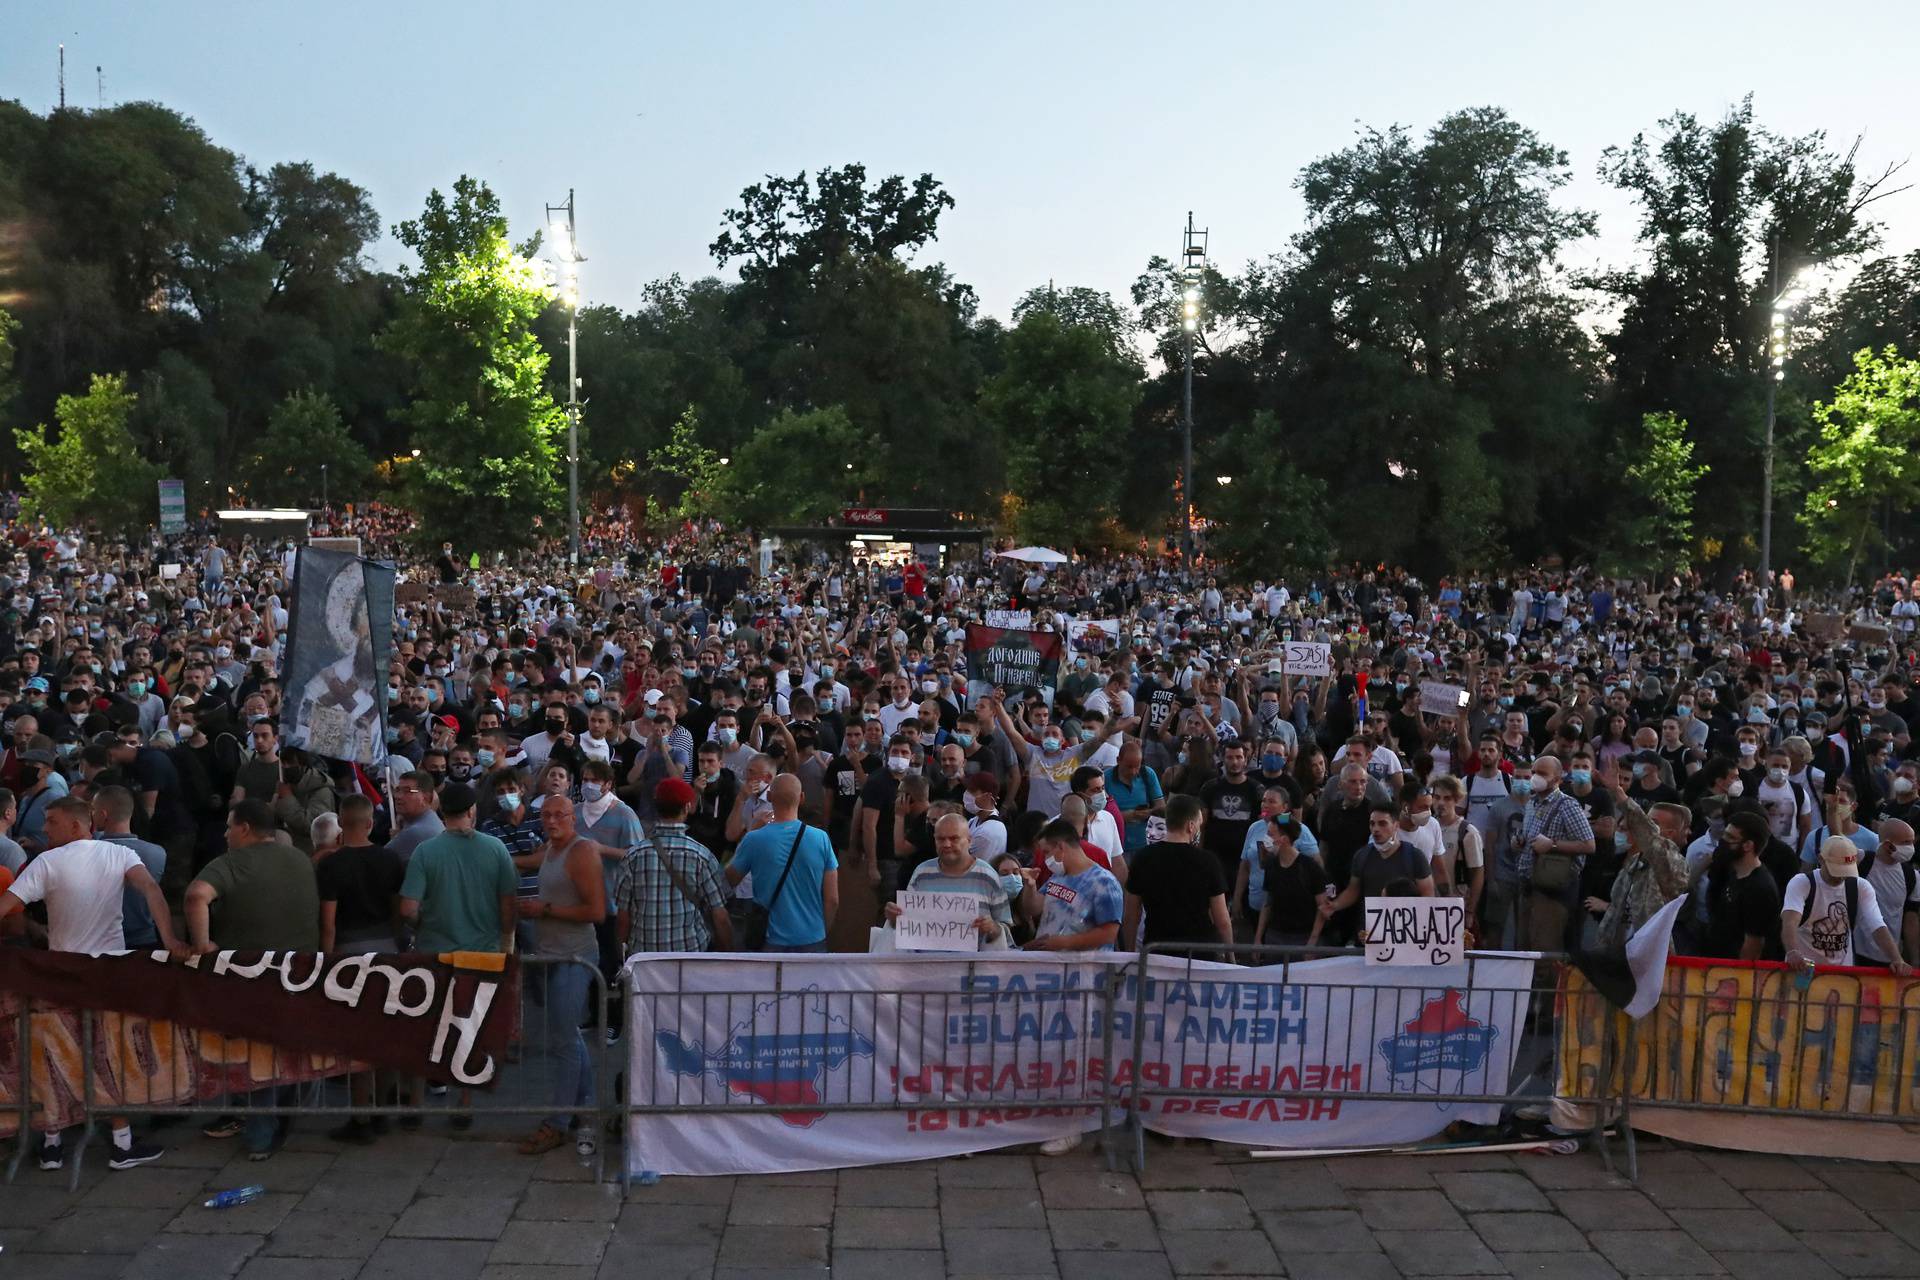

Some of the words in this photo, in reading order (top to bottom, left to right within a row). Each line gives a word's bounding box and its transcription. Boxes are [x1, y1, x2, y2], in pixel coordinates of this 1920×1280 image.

[1152, 690, 1174, 701] STATE
[1060, 888, 1075, 902] OVER
[904, 894, 926, 909] НИ
[932, 894, 977, 914] КУРТА
[899, 920, 922, 937] НИ
[926, 921, 977, 940] МУРТА
